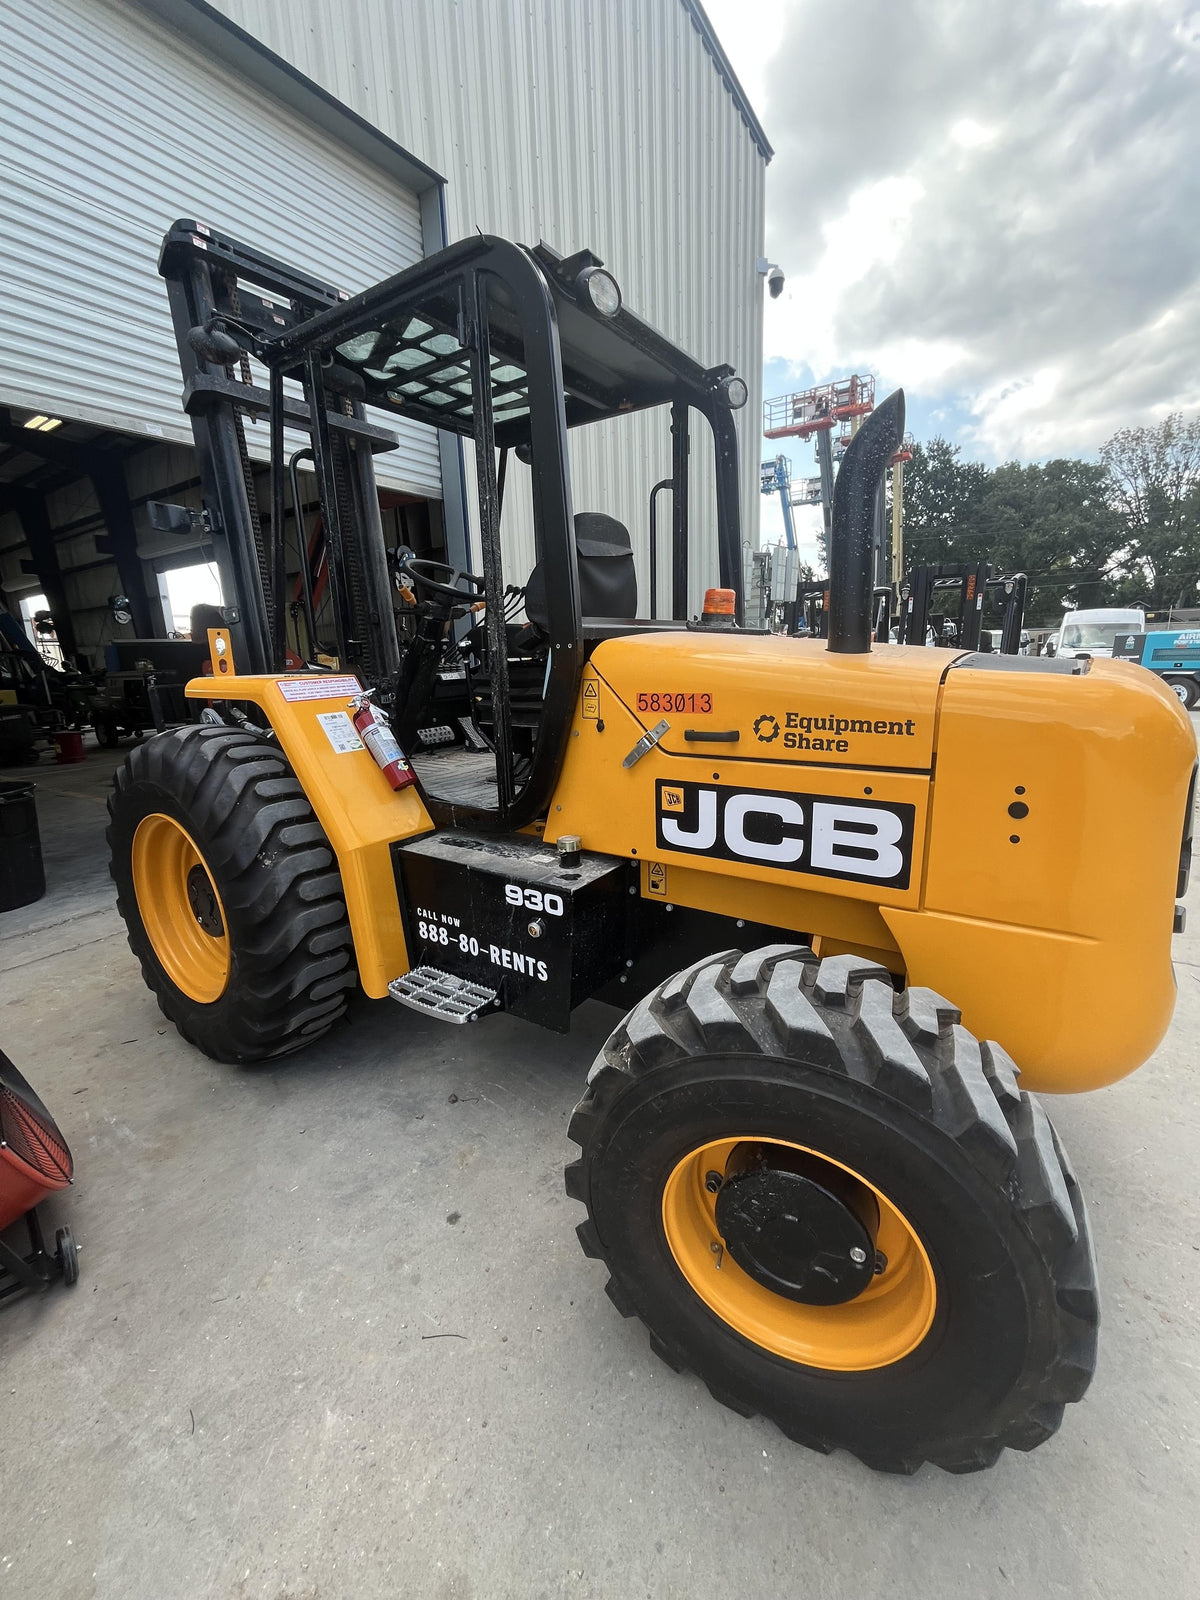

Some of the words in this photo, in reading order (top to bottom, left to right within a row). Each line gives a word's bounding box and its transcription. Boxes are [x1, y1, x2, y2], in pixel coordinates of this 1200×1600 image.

[638, 693, 712, 713] 583013
[785, 712, 916, 736] Equipment
[783, 732, 849, 753] Share
[661, 789, 904, 879] JCB
[504, 883, 564, 917] 930
[416, 907, 438, 921] CALL
[441, 914, 461, 928] NOW
[418, 920, 549, 982] 888-80-RENTS
